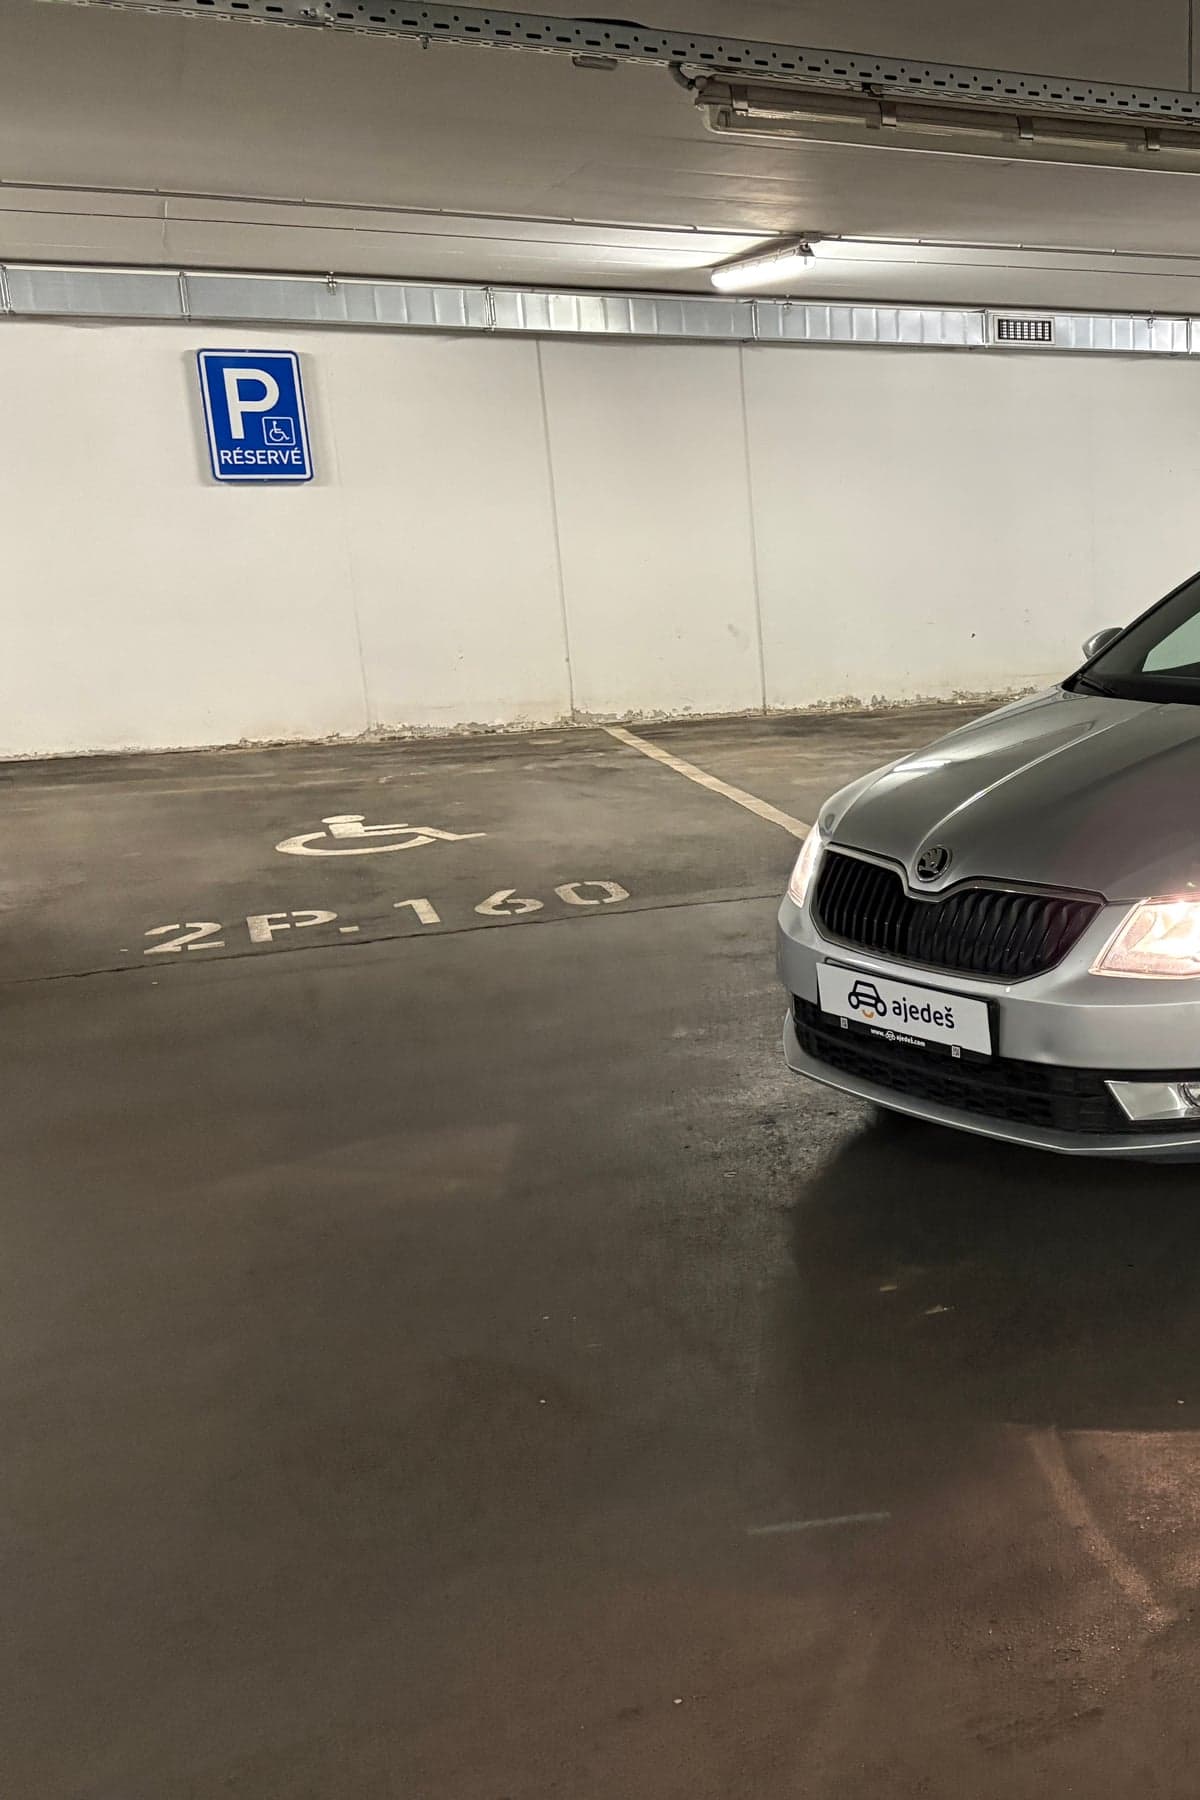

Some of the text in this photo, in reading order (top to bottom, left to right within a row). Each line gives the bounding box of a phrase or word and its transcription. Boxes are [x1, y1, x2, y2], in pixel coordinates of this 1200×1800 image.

[222, 367, 280, 440] P
[220, 446, 303, 465] RÉSERVÉ
[393, 880, 630, 925] 160
[892, 997, 955, 1029] ajedeš
